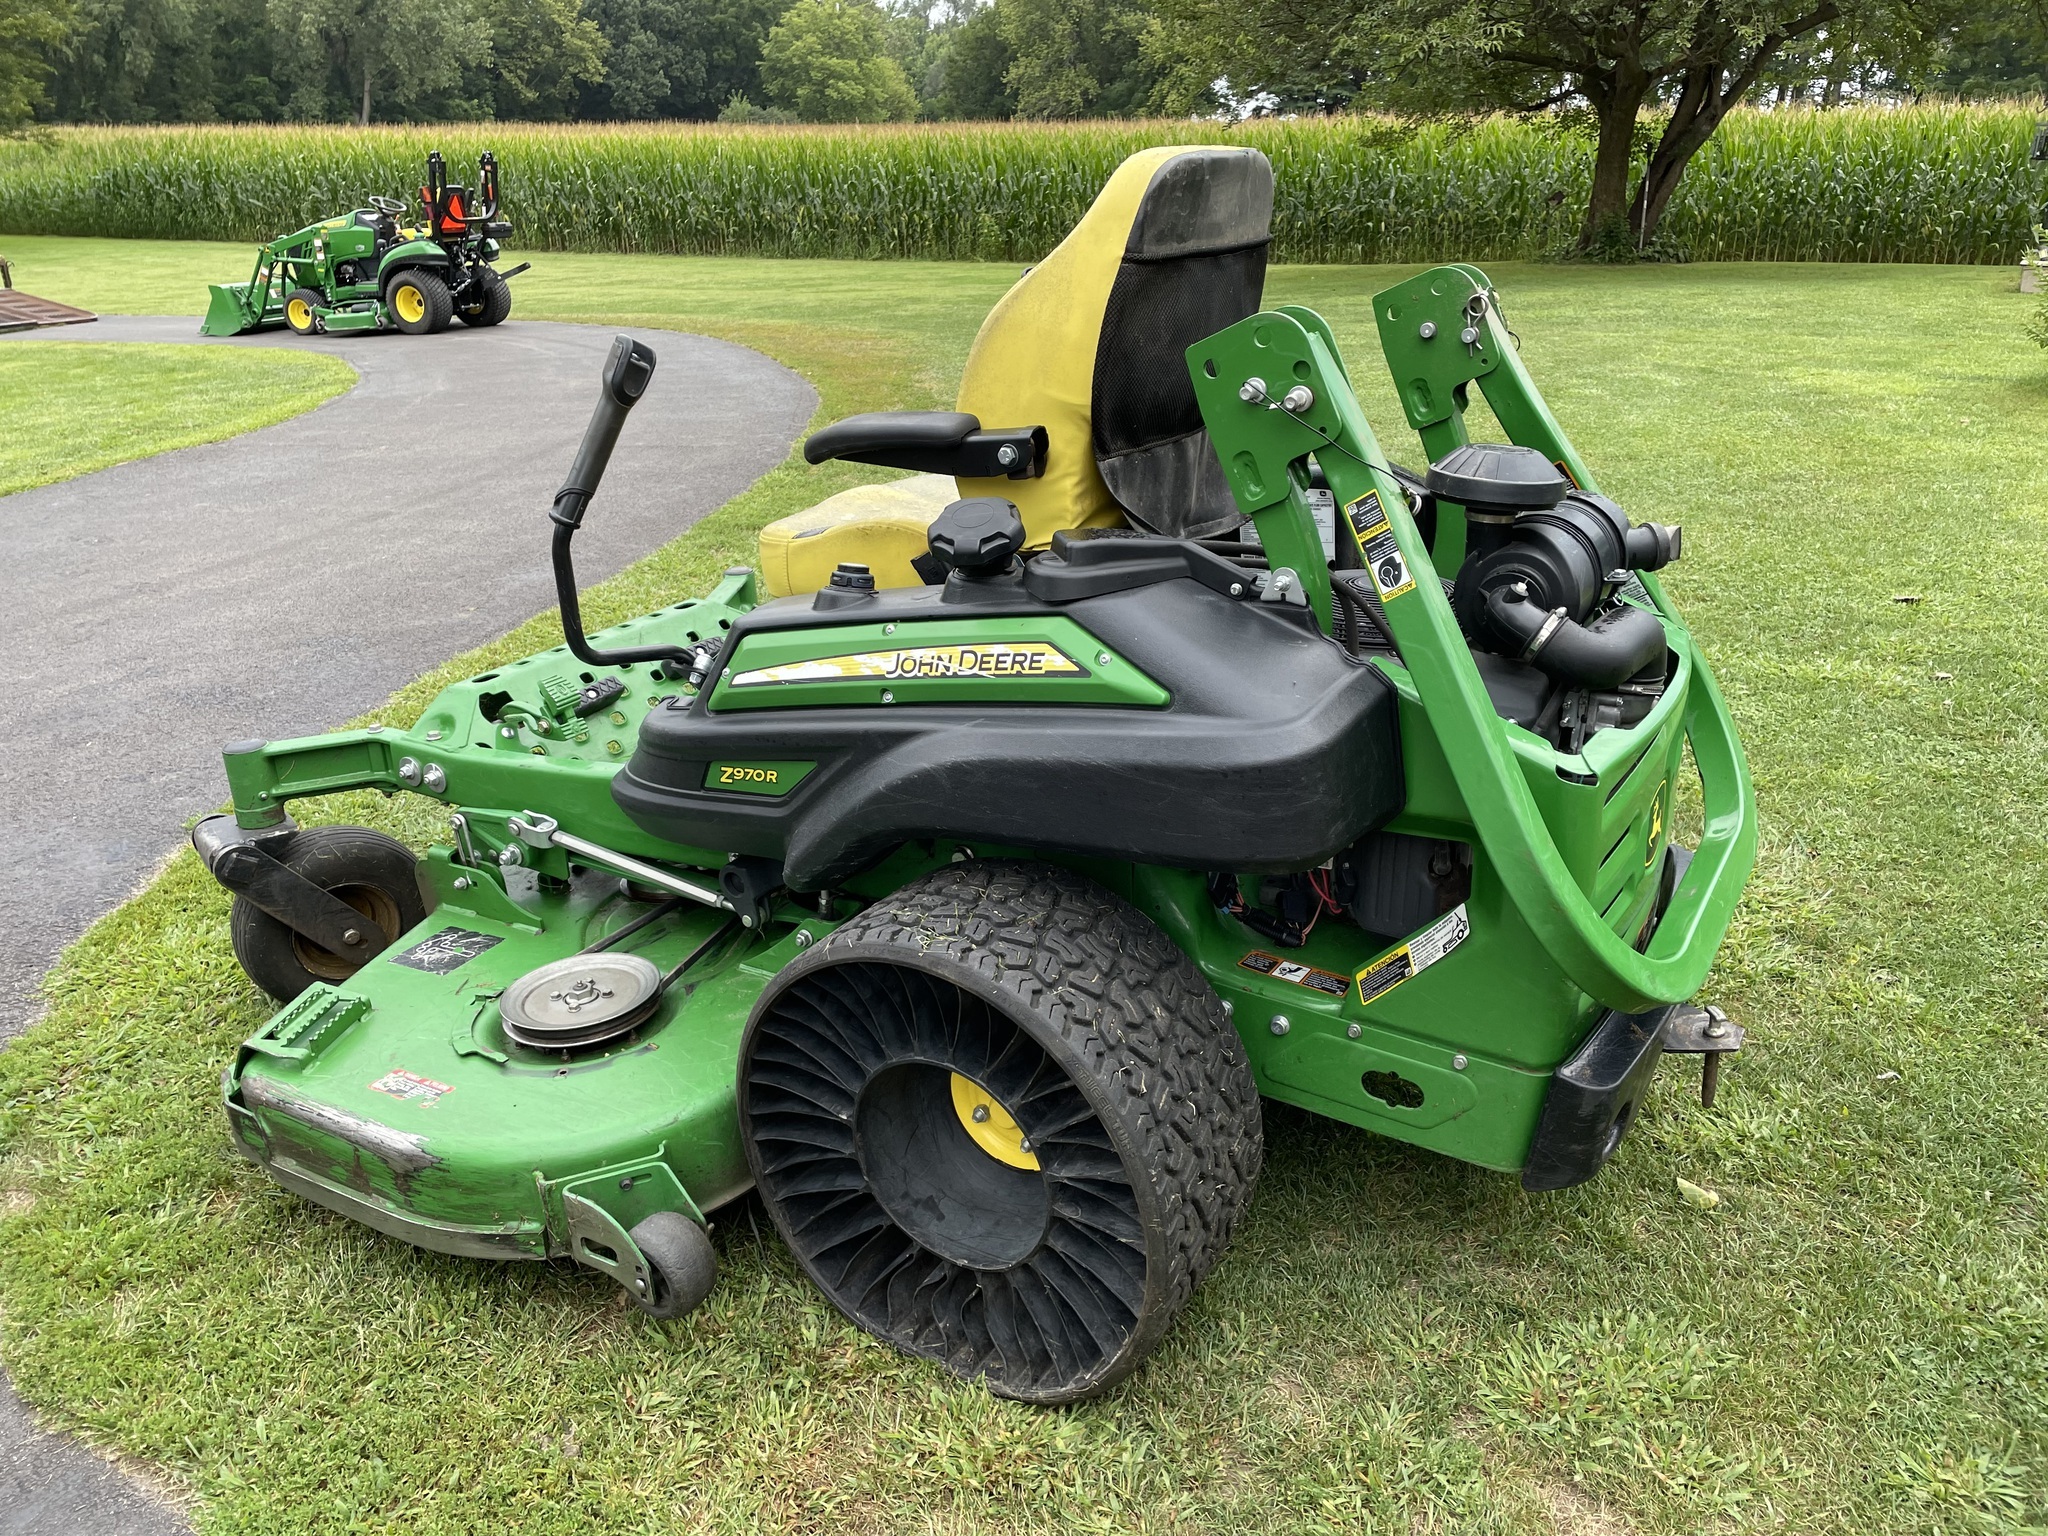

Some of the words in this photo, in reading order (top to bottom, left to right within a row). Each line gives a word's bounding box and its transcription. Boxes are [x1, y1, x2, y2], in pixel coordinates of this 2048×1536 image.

[1384, 584, 1410, 600] CAUTION
[886, 652, 952, 675] JOHN
[959, 649, 1046, 673] DEERE
[720, 766, 778, 783] Z970R
